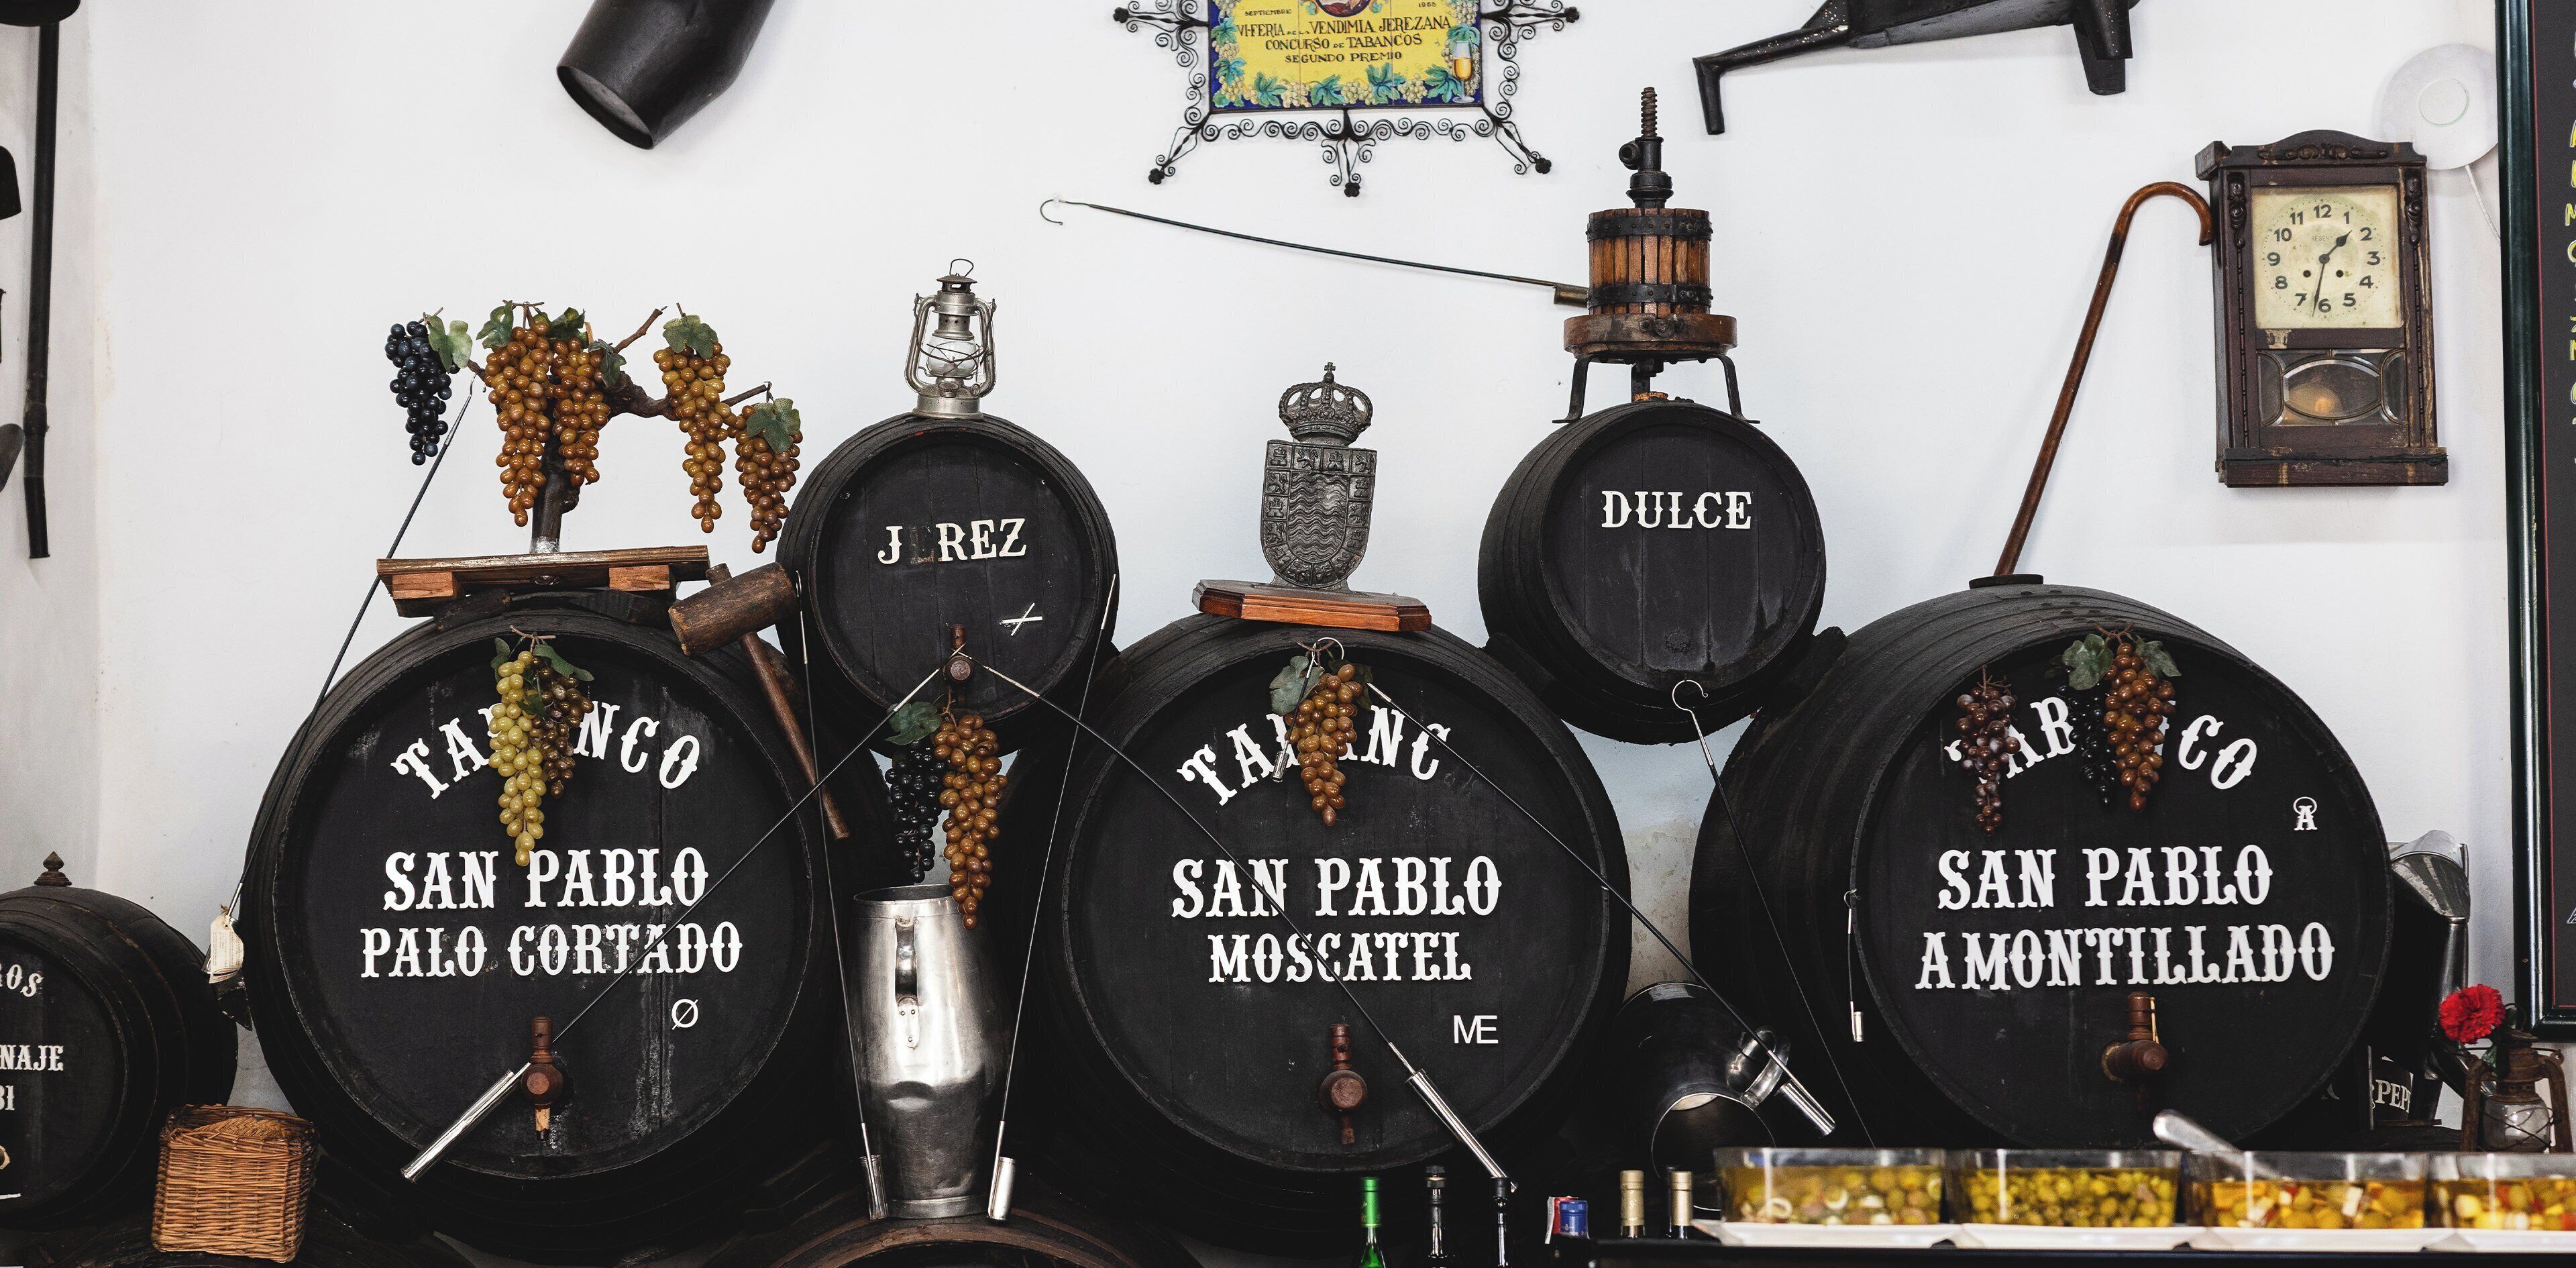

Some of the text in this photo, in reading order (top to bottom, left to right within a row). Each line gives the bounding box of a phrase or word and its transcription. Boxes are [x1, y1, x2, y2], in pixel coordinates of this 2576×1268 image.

[1309, 19, 1376, 34] VENDIMIA
[1379, 15, 1451, 34] JEREZANA
[1265, 36, 1330, 52] CONCURSO
[1346, 33, 1422, 48] TABANCOS
[1285, 51, 1402, 63] SEGUNDO PREMIO
[2290, 211, 2303, 225] 11
[2314, 204, 2332, 218] 12
[2343, 211, 2350, 224] 1
[2273, 228, 2292, 242] 10
[2360, 227, 2372, 241] 2
[2267, 252, 2281, 266] 9
[2367, 251, 2381, 265] 3
[2275, 276, 2288, 290] 8
[2359, 275, 2374, 288] 4
[2295, 293, 2308, 306] 7
[2318, 298, 2332, 313] 6
[2343, 293, 2356, 307] 5
[1601, 490, 1752, 529] DULCE
[877, 518, 1027, 564] JREZ
[390, 700, 700, 800] TANCO
[382, 847, 709, 911] SAN PABLO
[1937, 844, 2273, 910] SAN PABLO
[1171, 855, 1502, 918] SAN PABLO
[360, 921, 743, 978] PALO CORTADO
[1208, 931, 1472, 983] MOSCATEL
[1915, 922, 2335, 991] AMONTILLADO
[0, 962, 44, 998] OS
